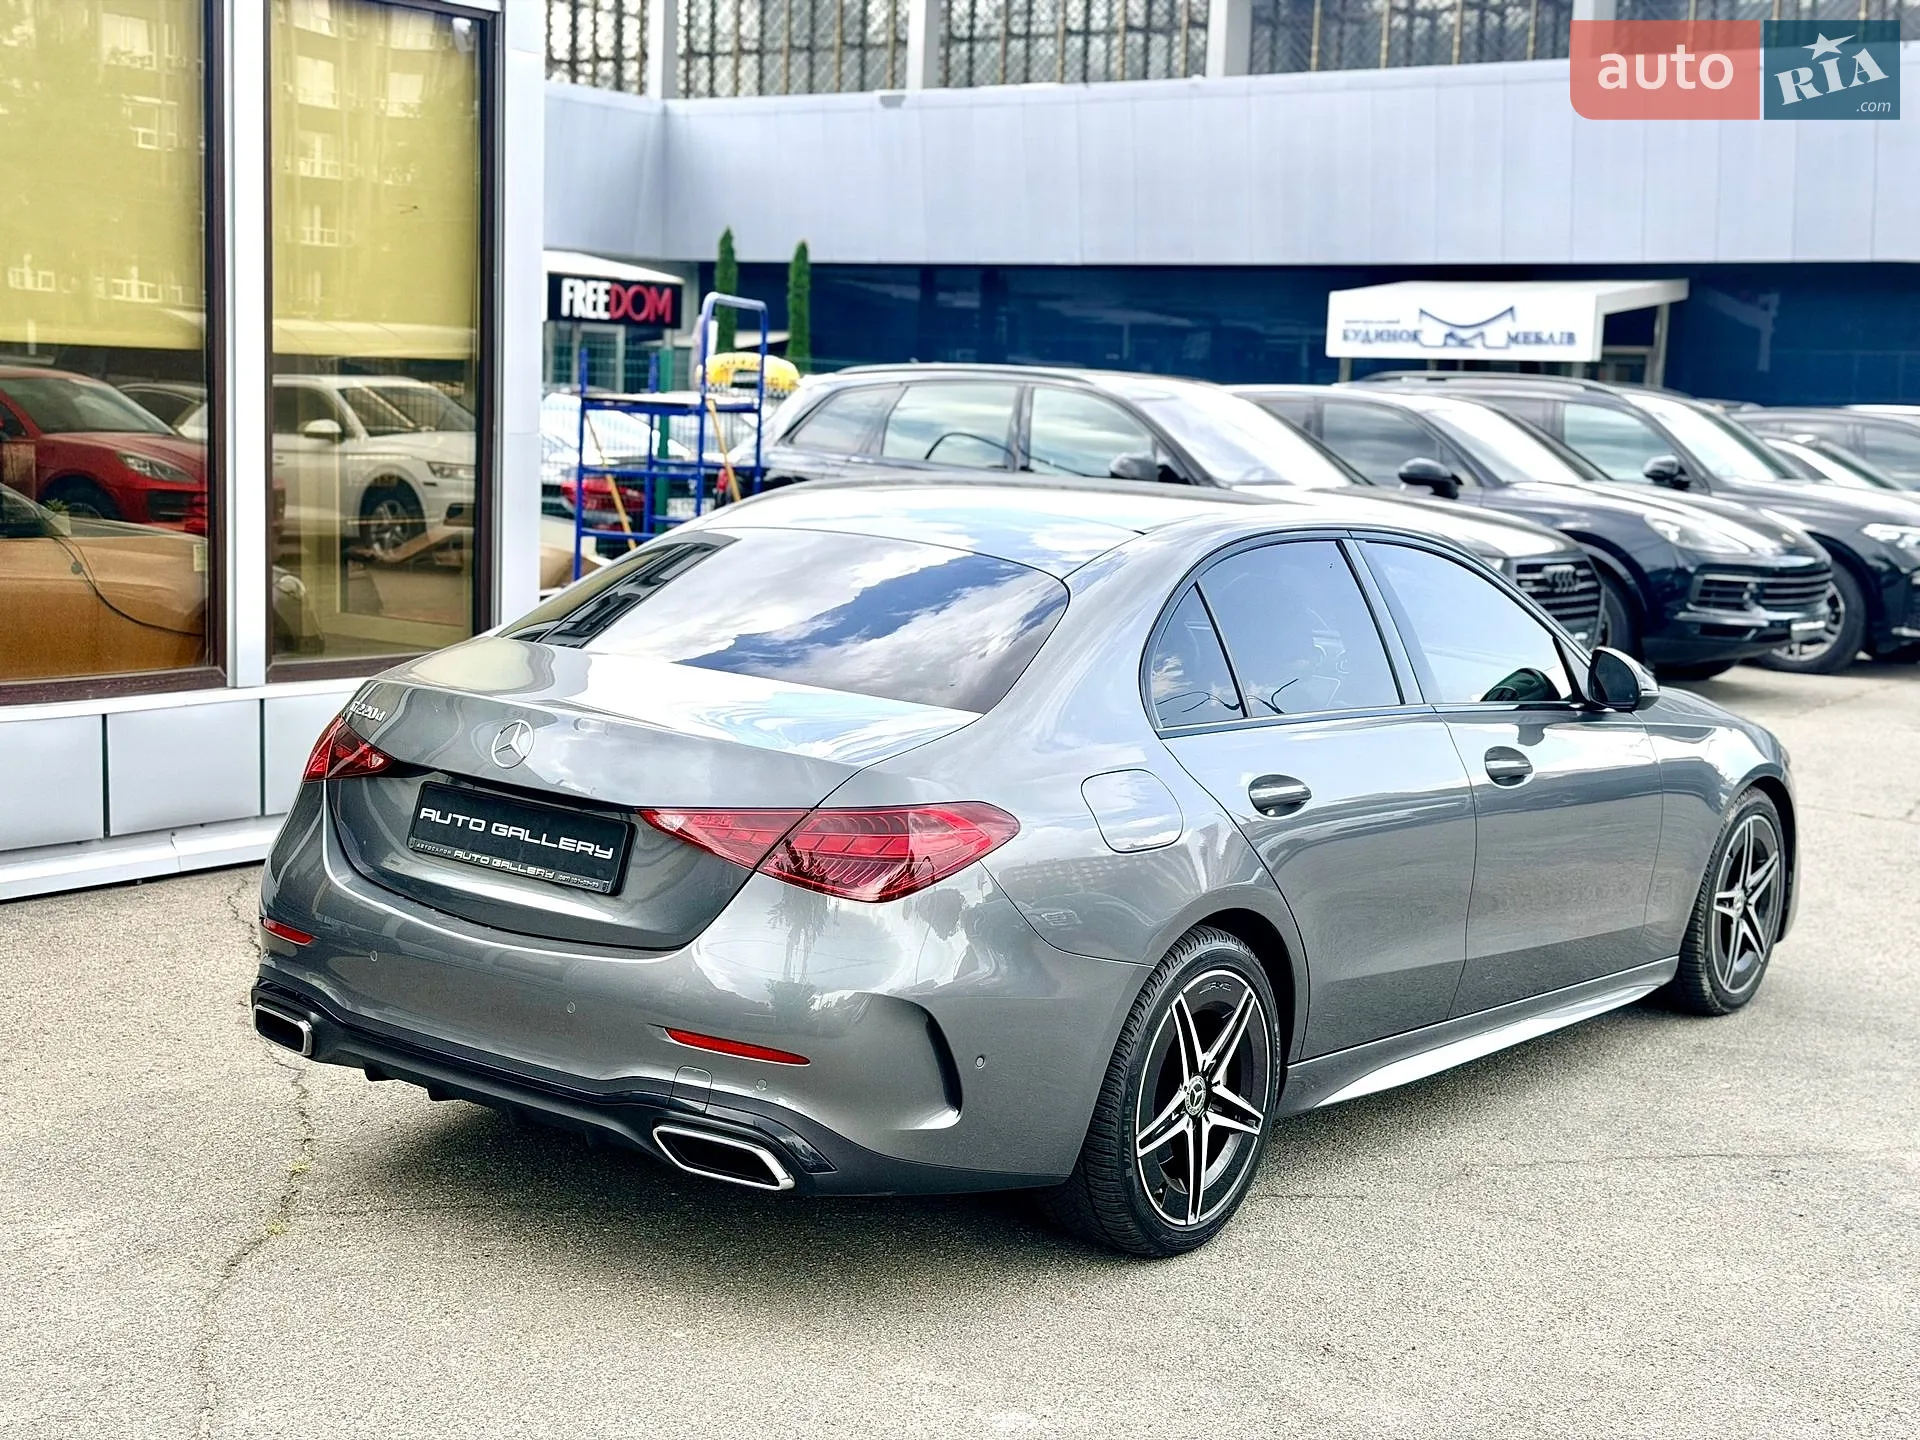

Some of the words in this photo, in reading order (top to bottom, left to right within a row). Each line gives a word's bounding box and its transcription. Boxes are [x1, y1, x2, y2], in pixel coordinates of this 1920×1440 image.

[561, 278, 673, 324] FREEDOM
[419, 807, 486, 832] AUTO
[490, 822, 614, 860] GALLERY
[453, 850, 490, 864] AUTO
[492, 858, 555, 879] GALLERY
